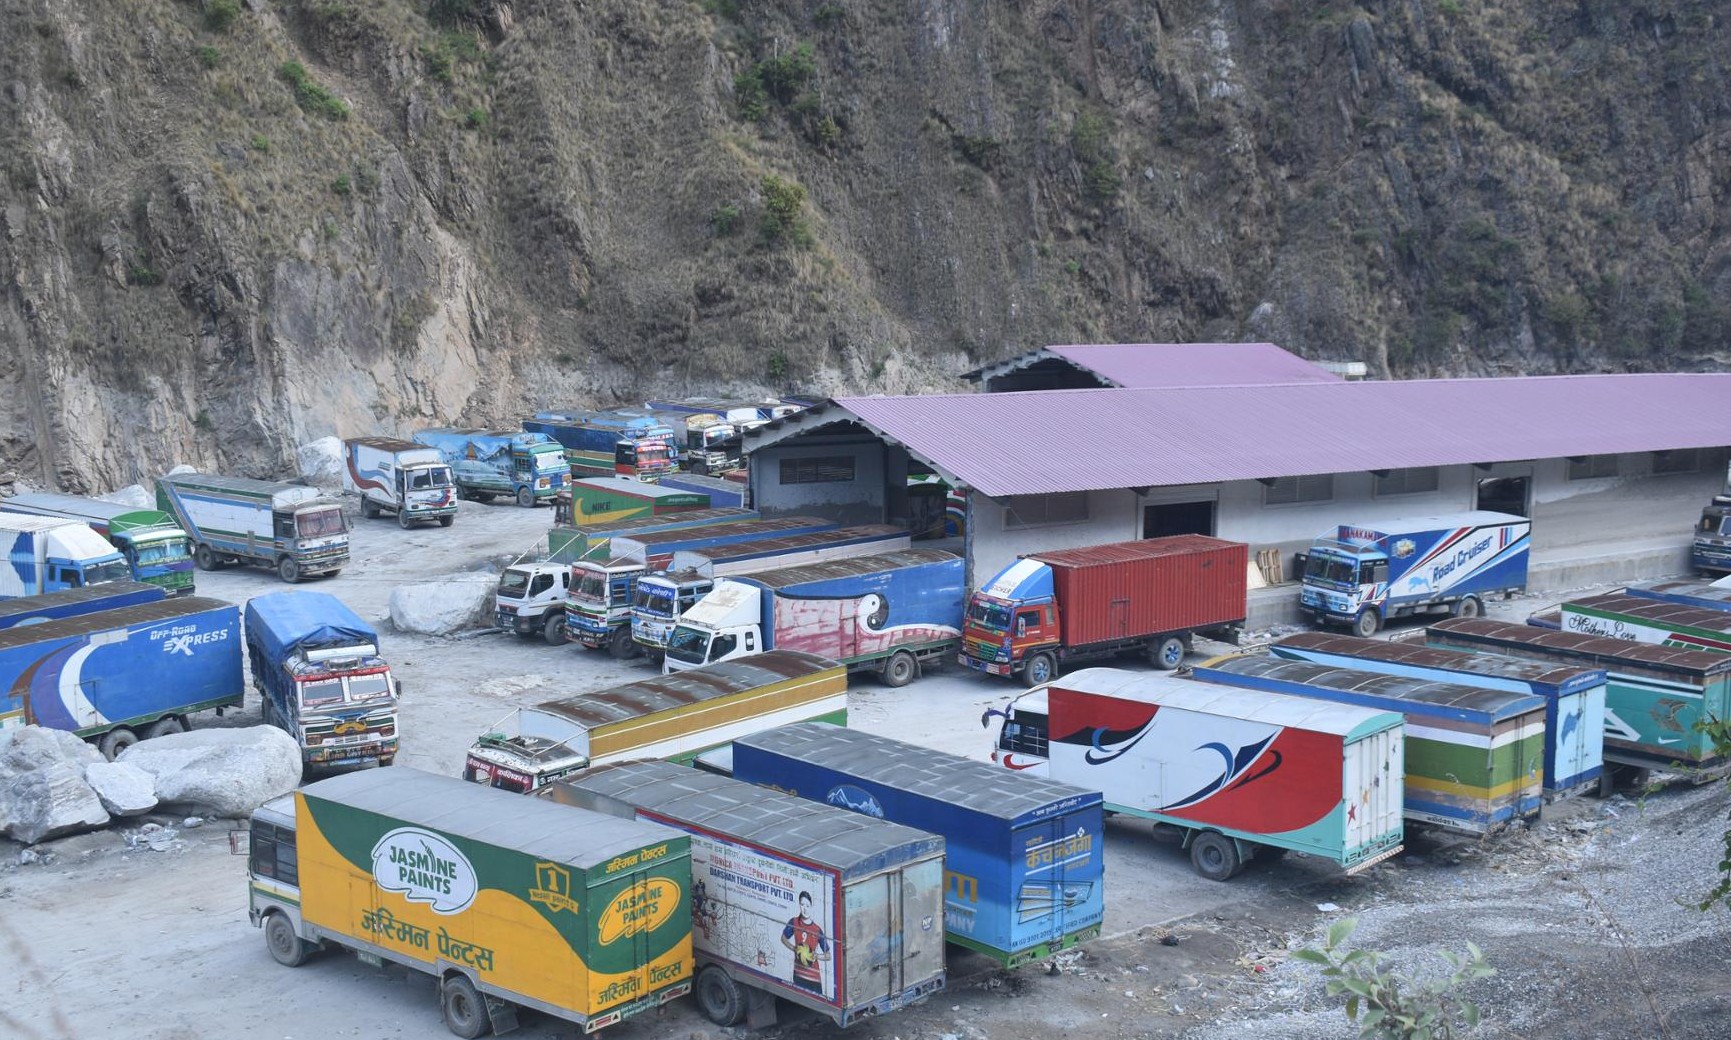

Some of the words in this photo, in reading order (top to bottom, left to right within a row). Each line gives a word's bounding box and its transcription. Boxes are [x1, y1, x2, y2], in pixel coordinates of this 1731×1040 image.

[592, 502, 611, 512] NIKE
[1432, 555, 1456, 583] Road
[1457, 536, 1493, 567] Cruiser
[163, 629, 228, 656] EXPRESS
[389, 839, 458, 880] JASMINE
[399, 867, 451, 894] PAINTS
[710, 866, 736, 883] DARSHAN
[737, 875, 770, 894] TRANSPORT
[616, 887, 662, 913] JASMNE
[623, 902, 659, 923] PAINTS
